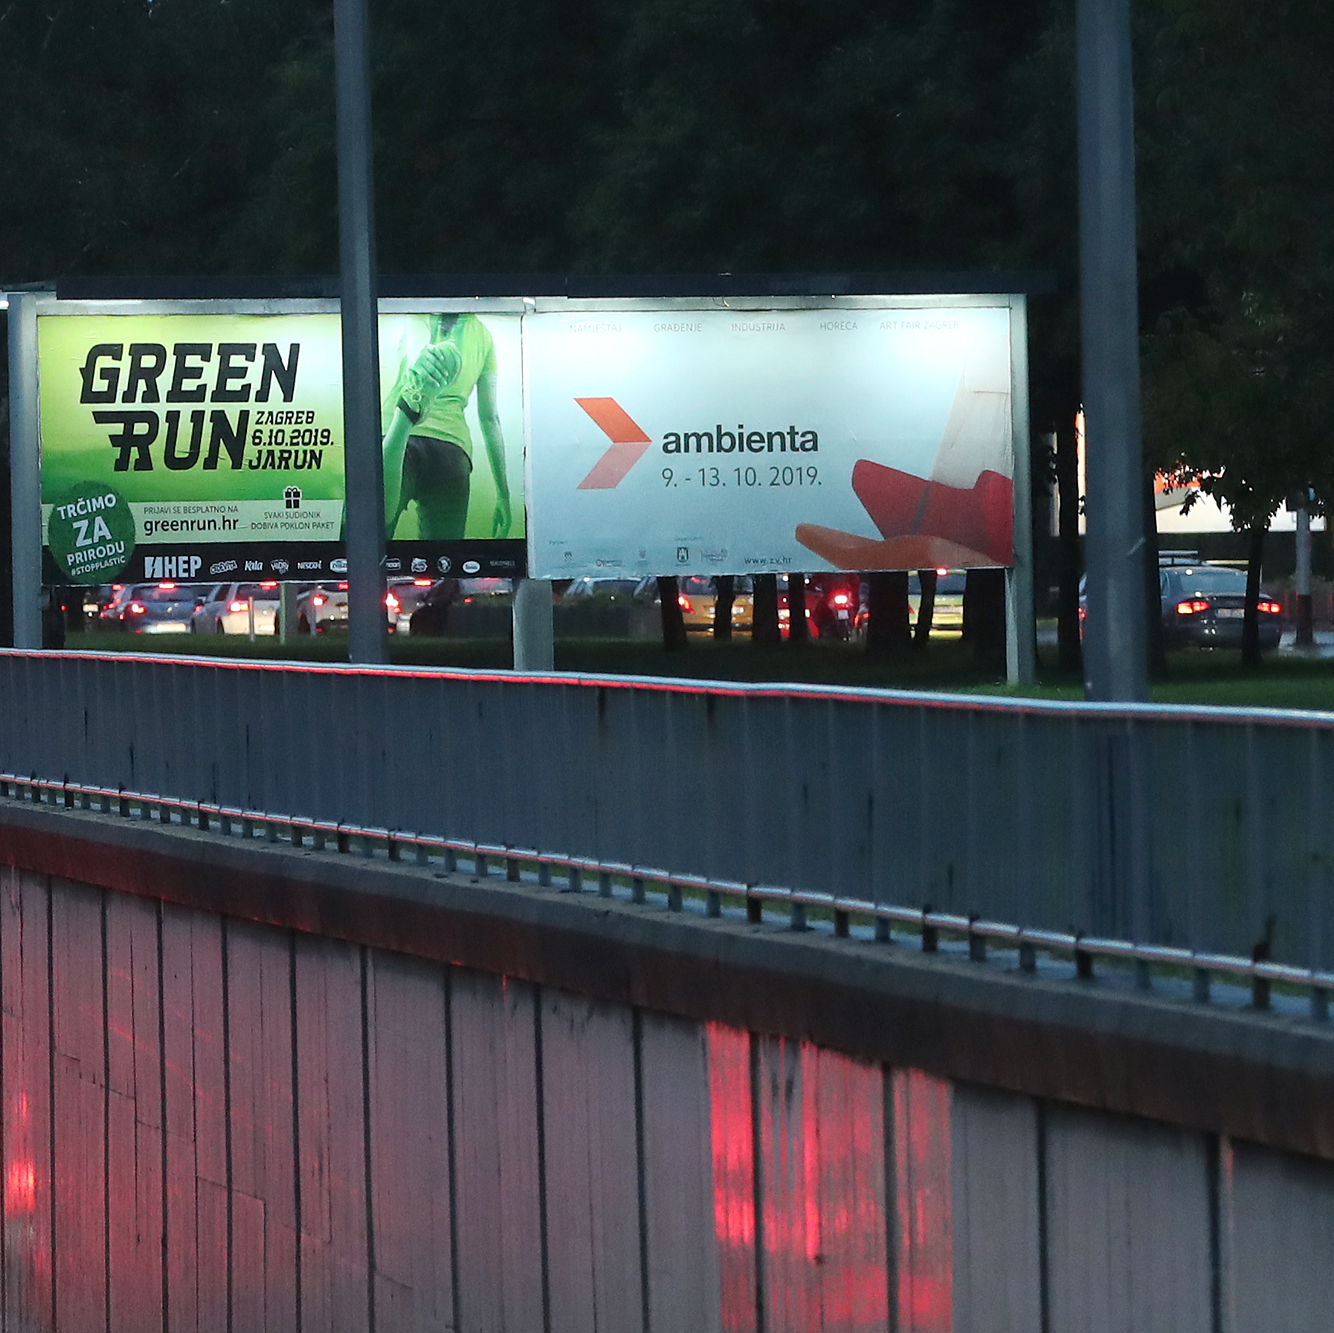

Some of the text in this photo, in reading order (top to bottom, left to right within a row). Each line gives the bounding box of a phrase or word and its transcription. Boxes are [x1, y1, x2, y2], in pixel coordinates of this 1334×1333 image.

[731, 322, 786, 332] INDUSTRIJA
[819, 321, 858, 331] HORECA
[879, 320, 960, 330] ART FAIR ZAGREB
[79, 342, 301, 404] GREEN
[255, 411, 315, 425] ZAGREB
[91, 410, 250, 471] RUN
[662, 424, 819, 454] ambienta
[248, 449, 323, 470] JARUN
[662, 467, 678, 487] 9.
[698, 467, 726, 487] 13.
[733, 467, 762, 487] 10.
[769, 466, 822, 486] 2019.
[56, 493, 116, 520] TRČIMO
[143, 505, 239, 515] PRIJAVI SE BESPLATNO NA
[72, 515, 112, 548] ZA
[143, 515, 240, 536] greenrun.hr
[66, 540, 125, 566] PRIRODU
[71, 555, 126, 577] #STOPPLASTIC
